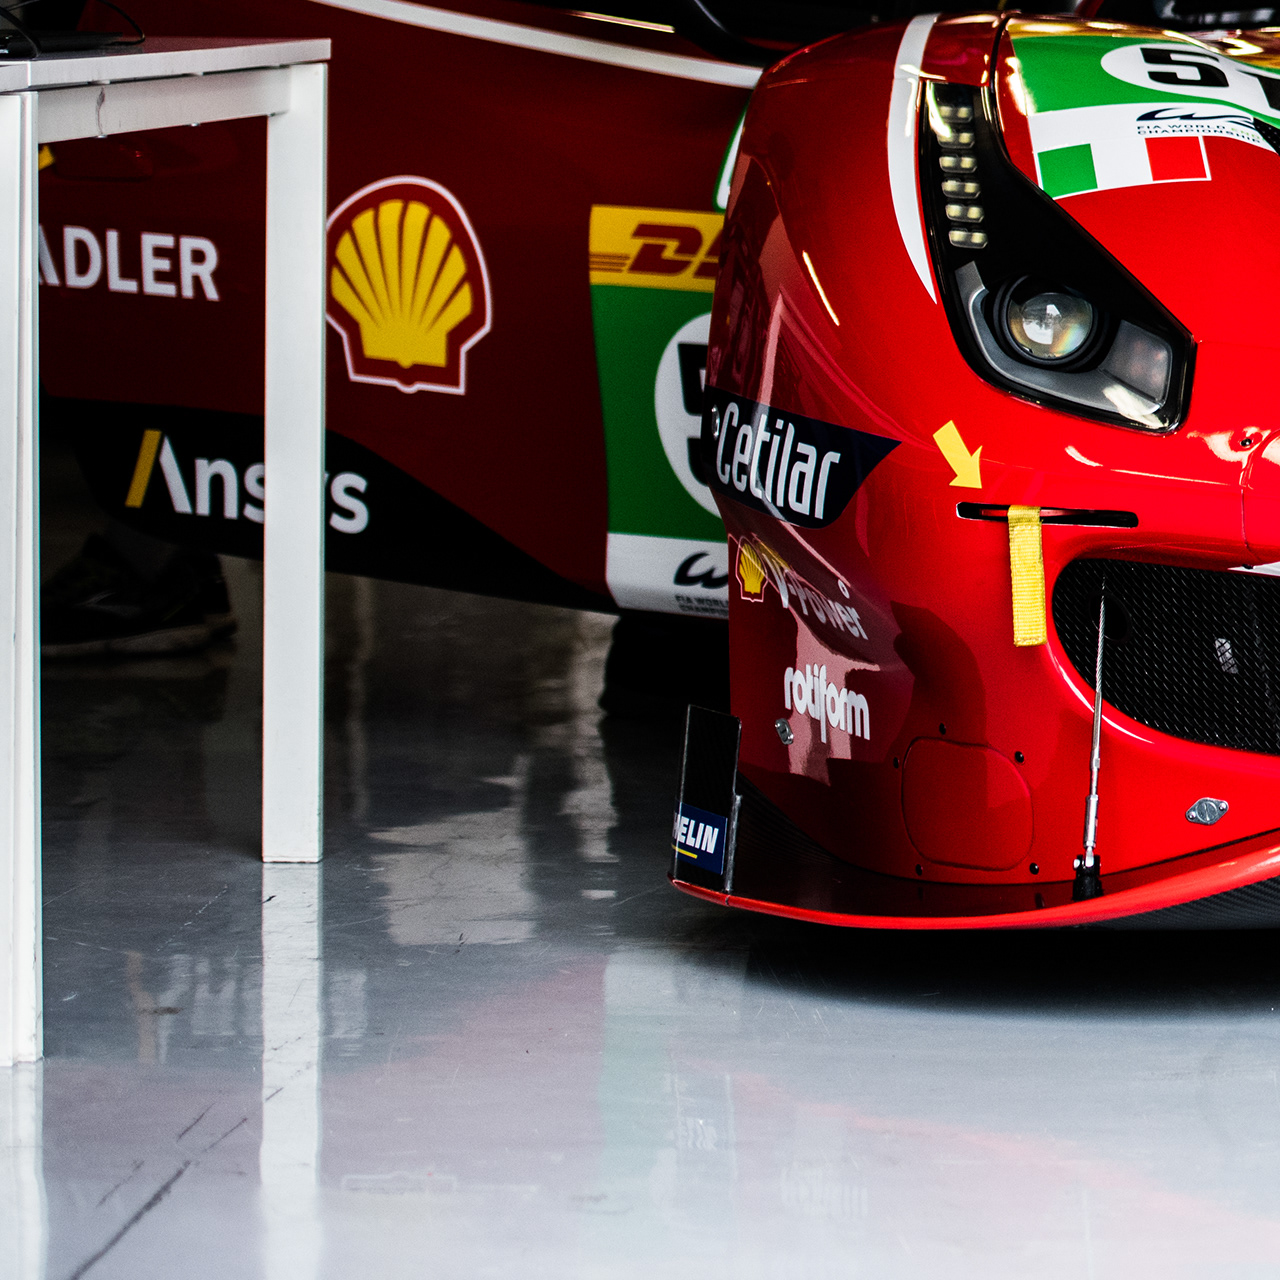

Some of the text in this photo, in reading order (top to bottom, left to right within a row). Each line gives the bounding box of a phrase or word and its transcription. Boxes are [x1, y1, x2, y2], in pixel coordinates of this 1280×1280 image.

[1137, 128, 1260, 143] CHAMPIONSHIP
[125, 428, 369, 535] Anss
[716, 401, 841, 520] Cetilar
[784, 663, 870, 744] rotiform
